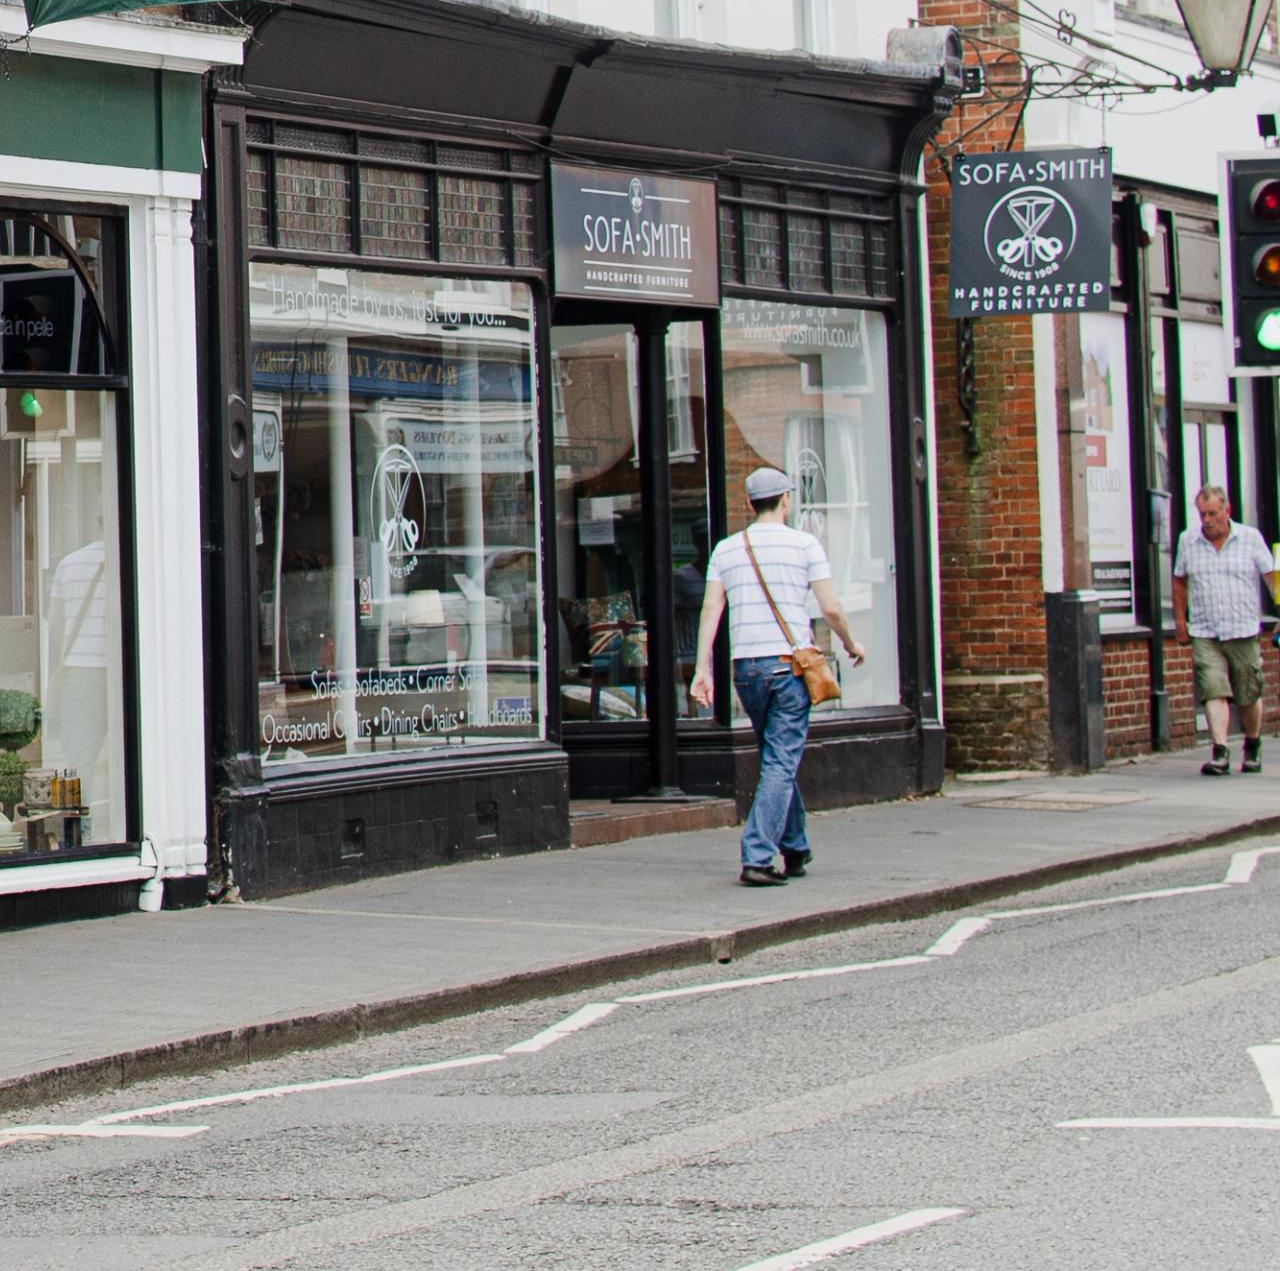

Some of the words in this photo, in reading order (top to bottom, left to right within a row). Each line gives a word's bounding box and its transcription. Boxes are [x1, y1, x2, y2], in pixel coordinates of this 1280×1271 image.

[586, 270, 643, 285] HANDCRAFTED
[646, 274, 689, 288] FURNITURE
[999, 263, 1032, 281] SINCE
[1035, 262, 1060, 279] 1908
[272, 274, 359, 316] Handmade
[954, 282, 1104, 300] HANDCRAFTED
[971, 296, 1086, 312] FURNITURE
[27, 315, 54, 341] pelle
[416, 665, 456, 694] Corner
[262, 713, 330, 744] Occasional
[381, 706, 419, 741] Dining
[421, 704, 457, 733] Chairs
